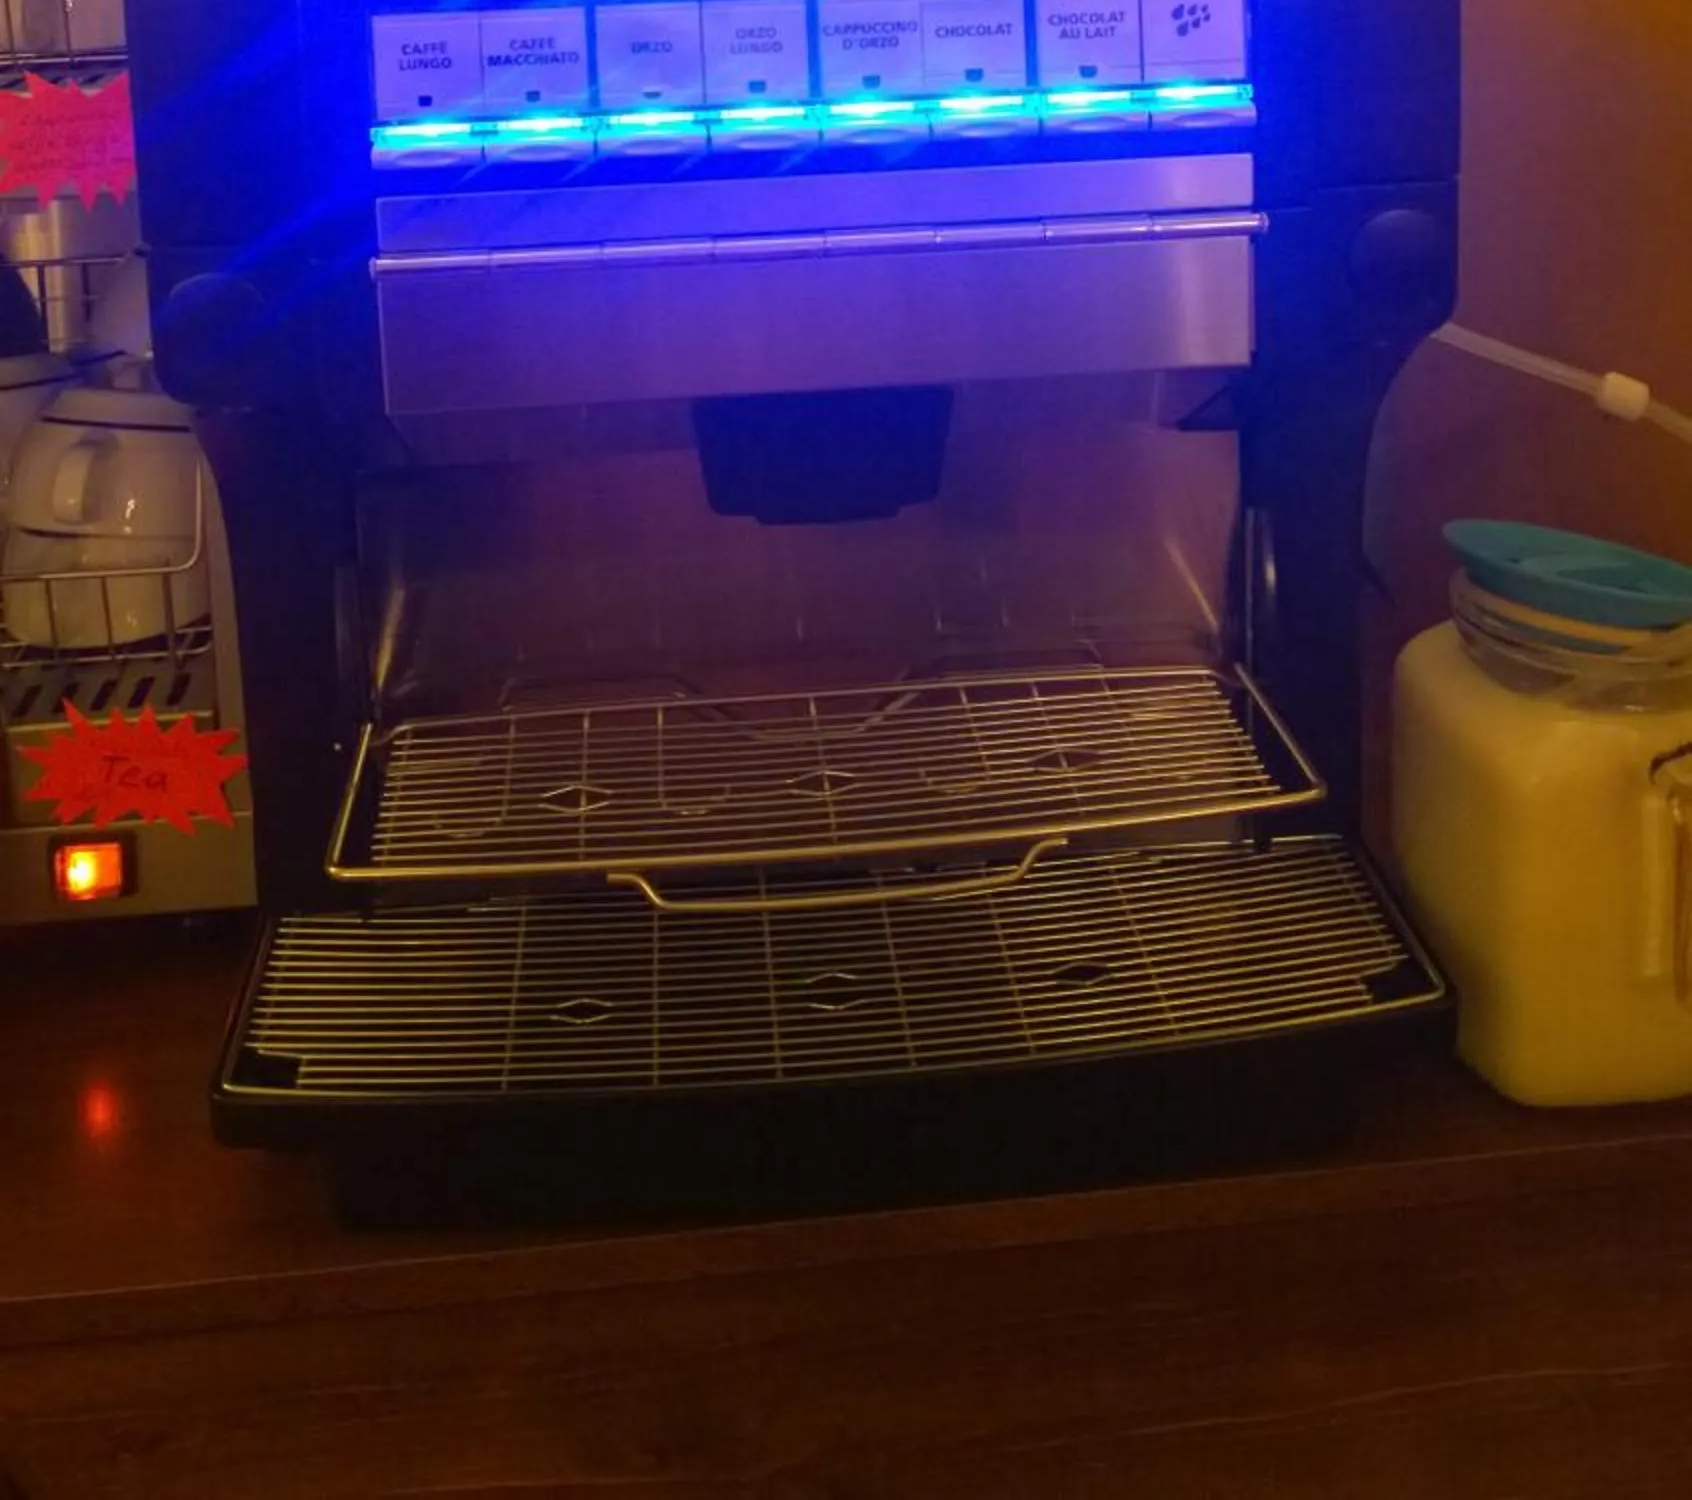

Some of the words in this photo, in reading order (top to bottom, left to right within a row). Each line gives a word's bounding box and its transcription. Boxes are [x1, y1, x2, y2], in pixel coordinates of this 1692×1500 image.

[1047, 10, 1127, 27] CHOCOLAT
[822, 20, 919, 37] CAPPUCCINO
[934, 22, 1014, 39] CHOCOLAT
[1058, 27, 1081, 39] AU
[1085, 25, 1117, 39] LAIT
[729, 40, 784, 55] LUNGO
[399, 56, 453, 71] LUNGO
[487, 51, 580, 68] MACCHIATO
[102, 755, 168, 792] Tea
